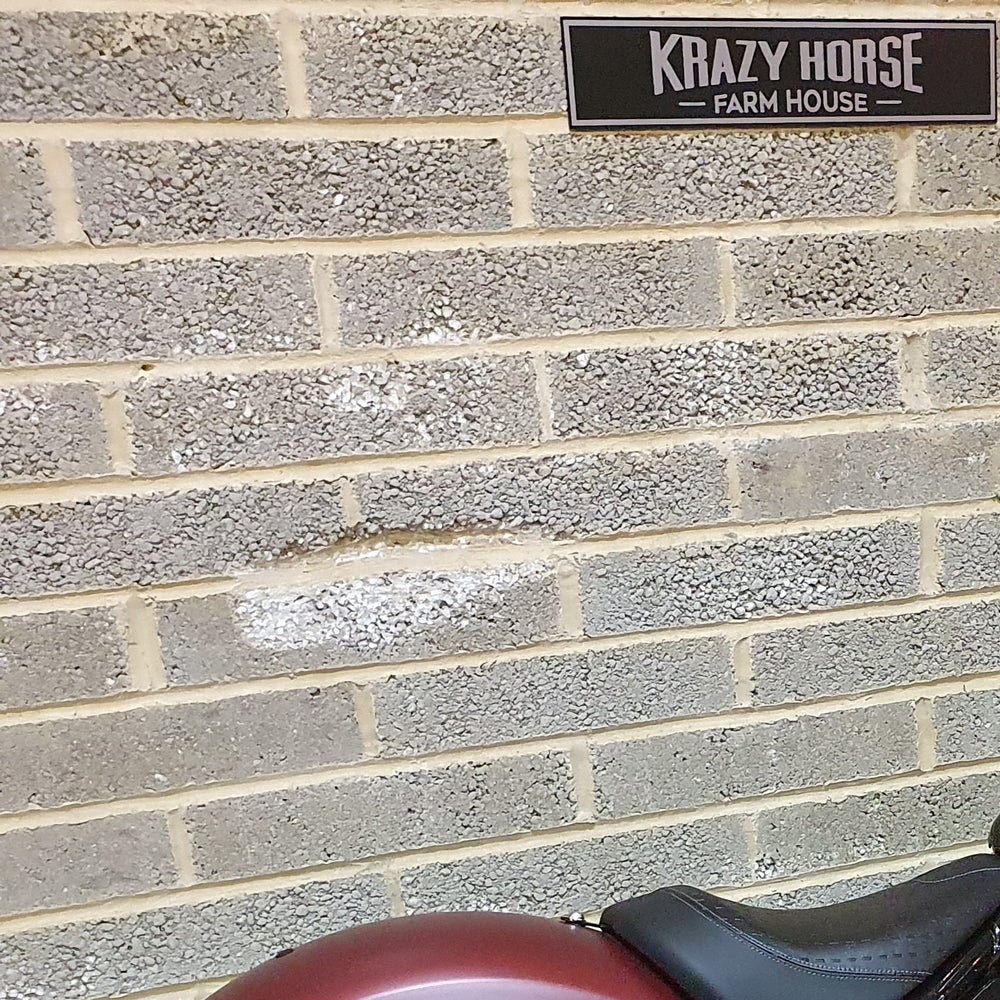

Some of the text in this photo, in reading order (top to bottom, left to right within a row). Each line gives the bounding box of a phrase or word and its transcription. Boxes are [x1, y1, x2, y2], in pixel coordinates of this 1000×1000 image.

[648, 30, 924, 96] KRAZY HORSE
[713, 89, 869, 115] FARM HOUSE
